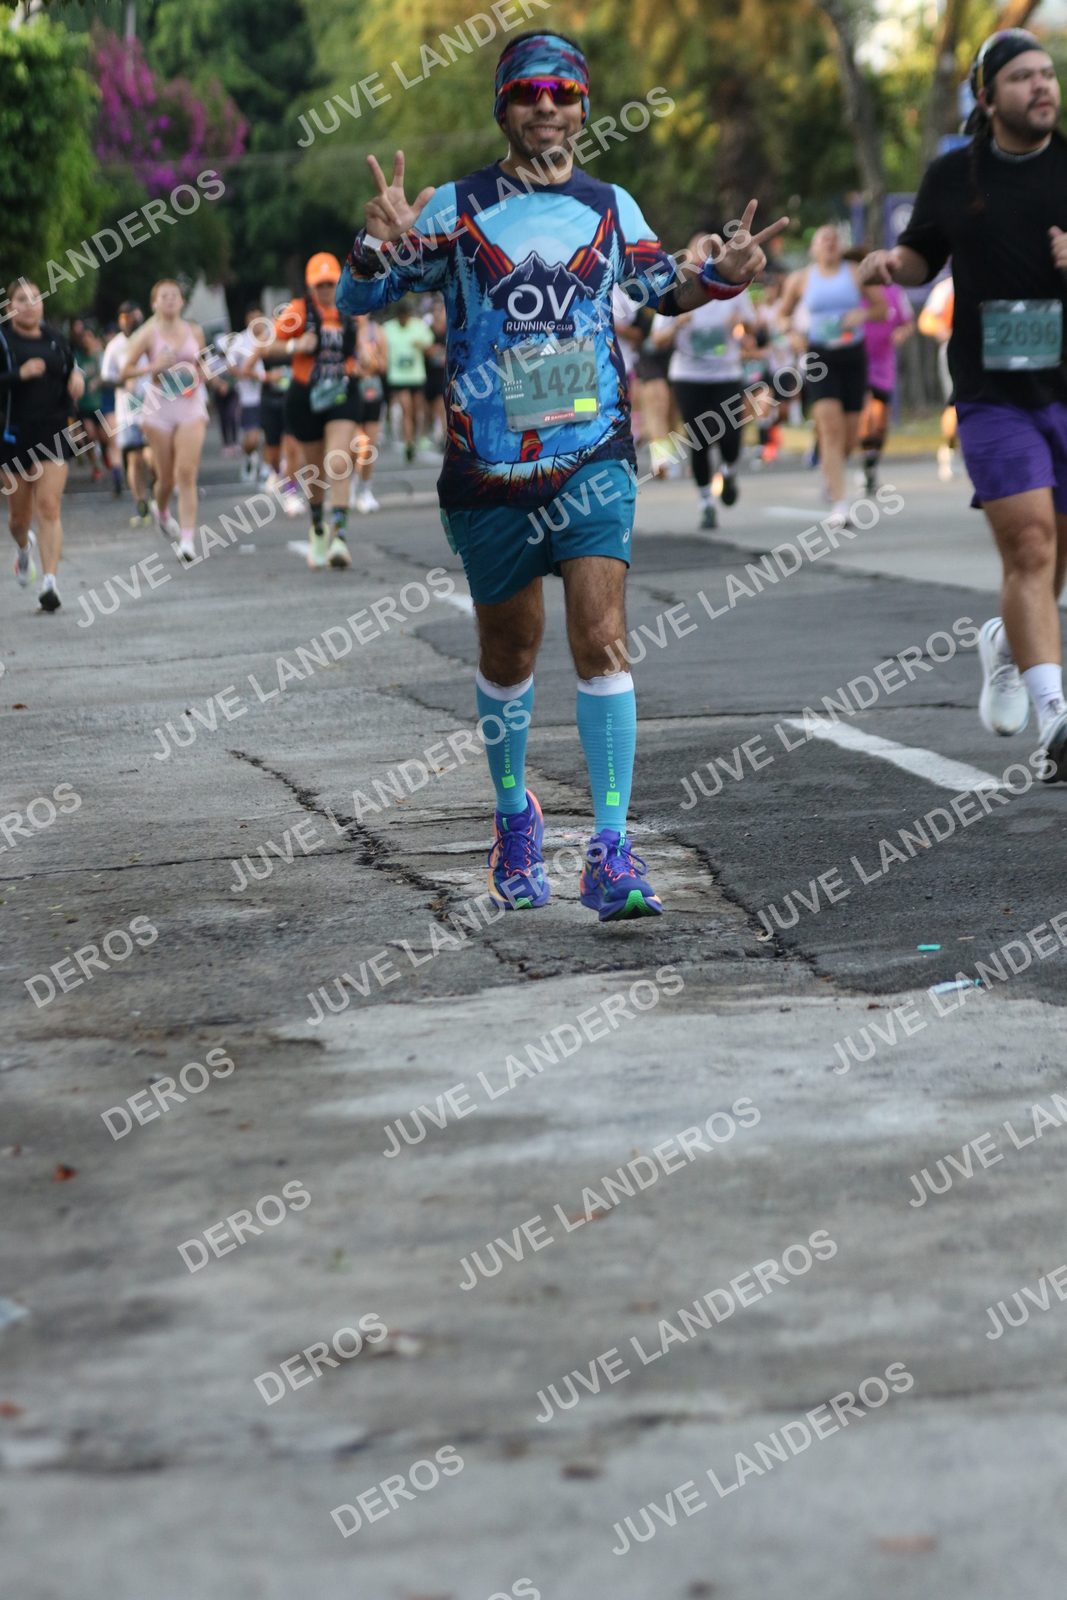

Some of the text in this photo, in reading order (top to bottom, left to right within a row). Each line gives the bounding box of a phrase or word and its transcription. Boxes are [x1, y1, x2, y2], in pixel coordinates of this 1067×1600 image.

[507, 283, 576, 321] OV
[506, 320, 555, 331] RUNNING
[998, 320, 1057, 346] 2696
[529, 361, 596, 400] 1422
[606, 712, 616, 789] COMPRESSPORT
